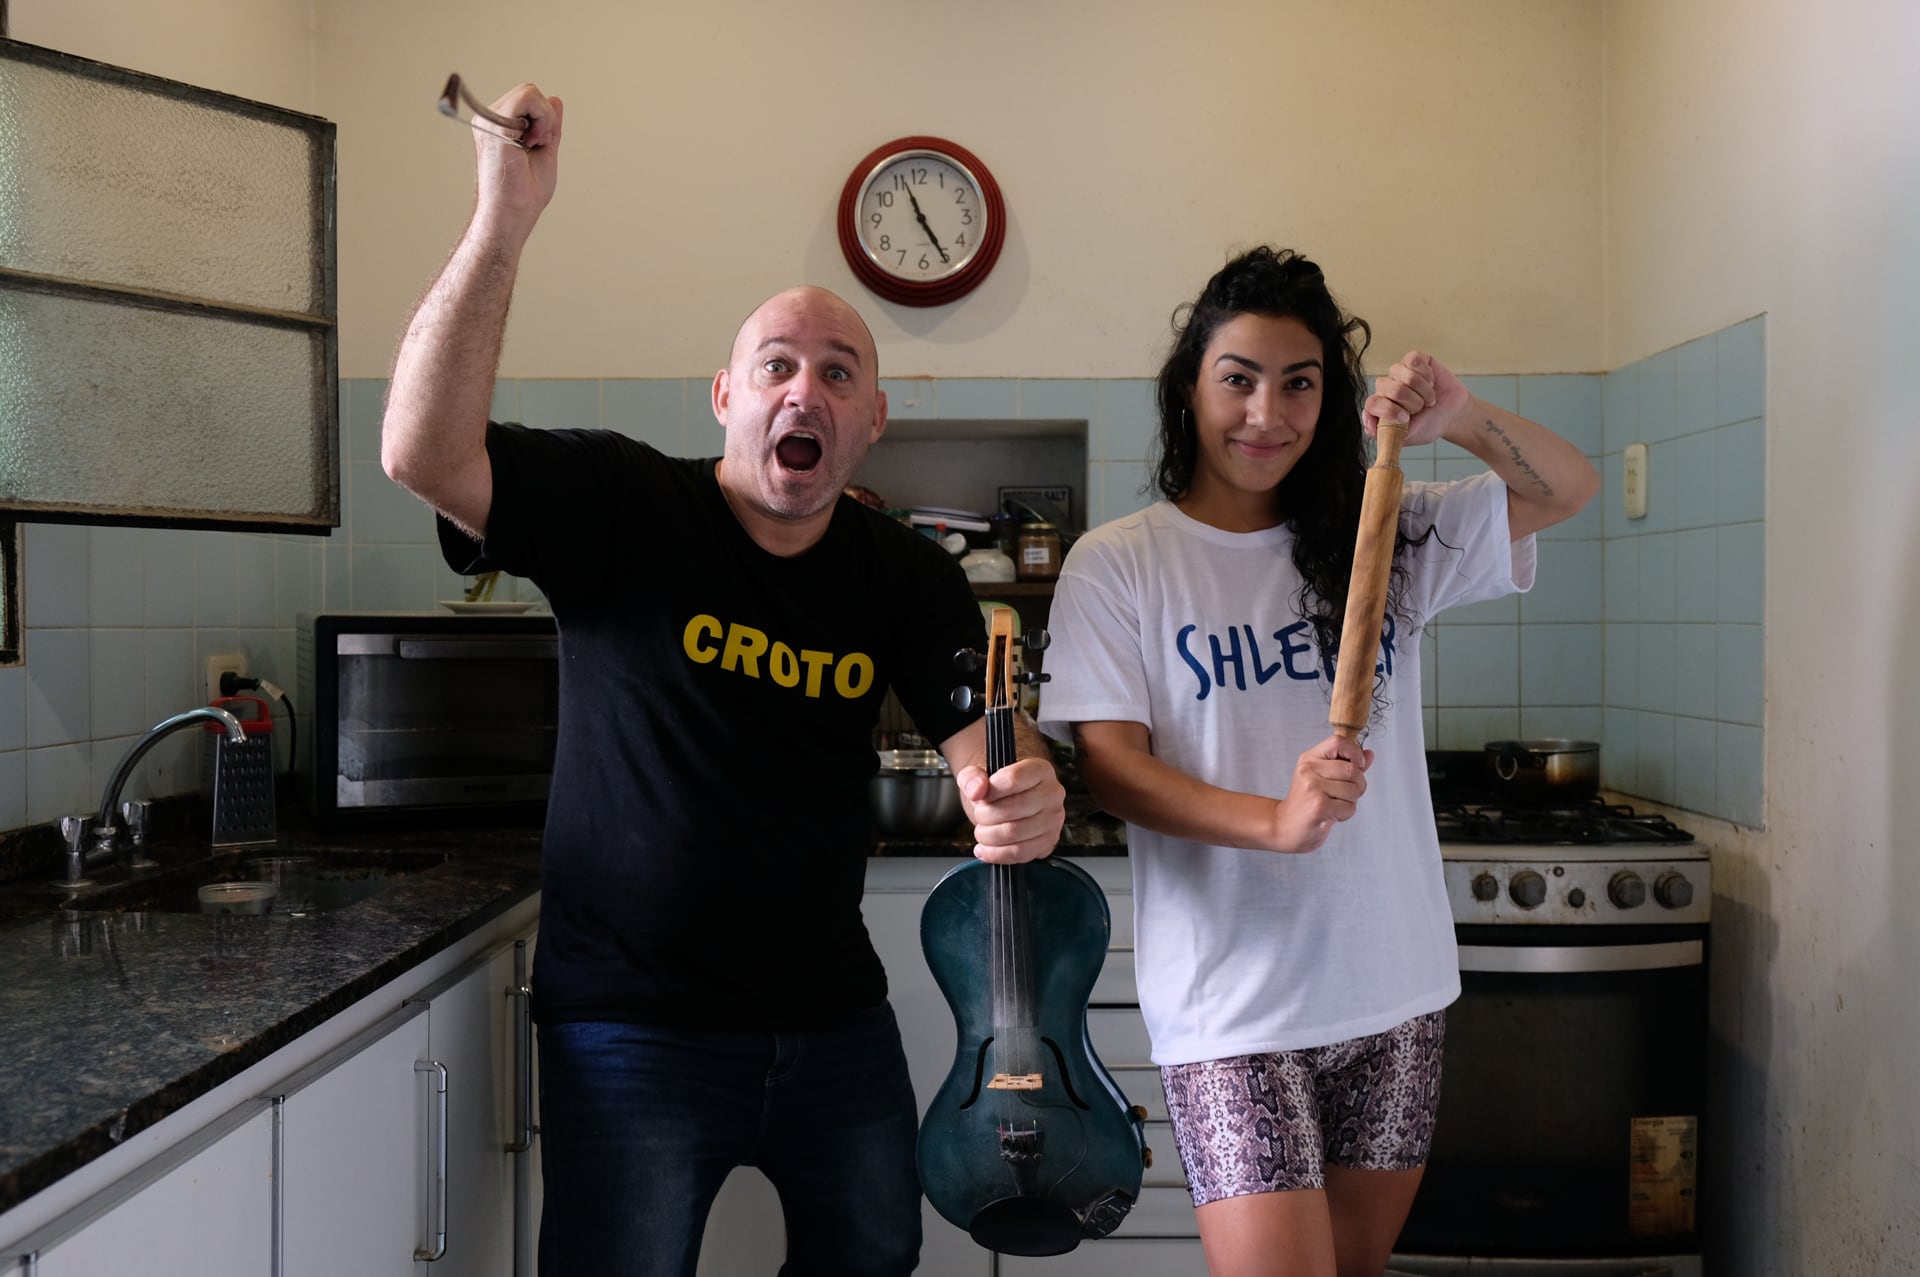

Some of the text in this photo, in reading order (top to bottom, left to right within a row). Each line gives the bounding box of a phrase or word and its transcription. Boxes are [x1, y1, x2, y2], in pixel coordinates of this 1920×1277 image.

[893, 174, 906, 191] 11
[911, 168, 928, 185] 12
[938, 172, 945, 189] 1
[876, 191, 894, 208] 10
[954, 187, 966, 205] 2
[871, 212, 883, 230] 9
[960, 208, 972, 225] 3
[879, 234, 891, 251] 8
[954, 232, 966, 248] 4
[896, 249, 907, 266] 7
[917, 253, 930, 270] 6
[939, 247, 951, 264] 5
[682, 613, 875, 699] CROTO
[1176, 611, 1396, 701] SHLER
